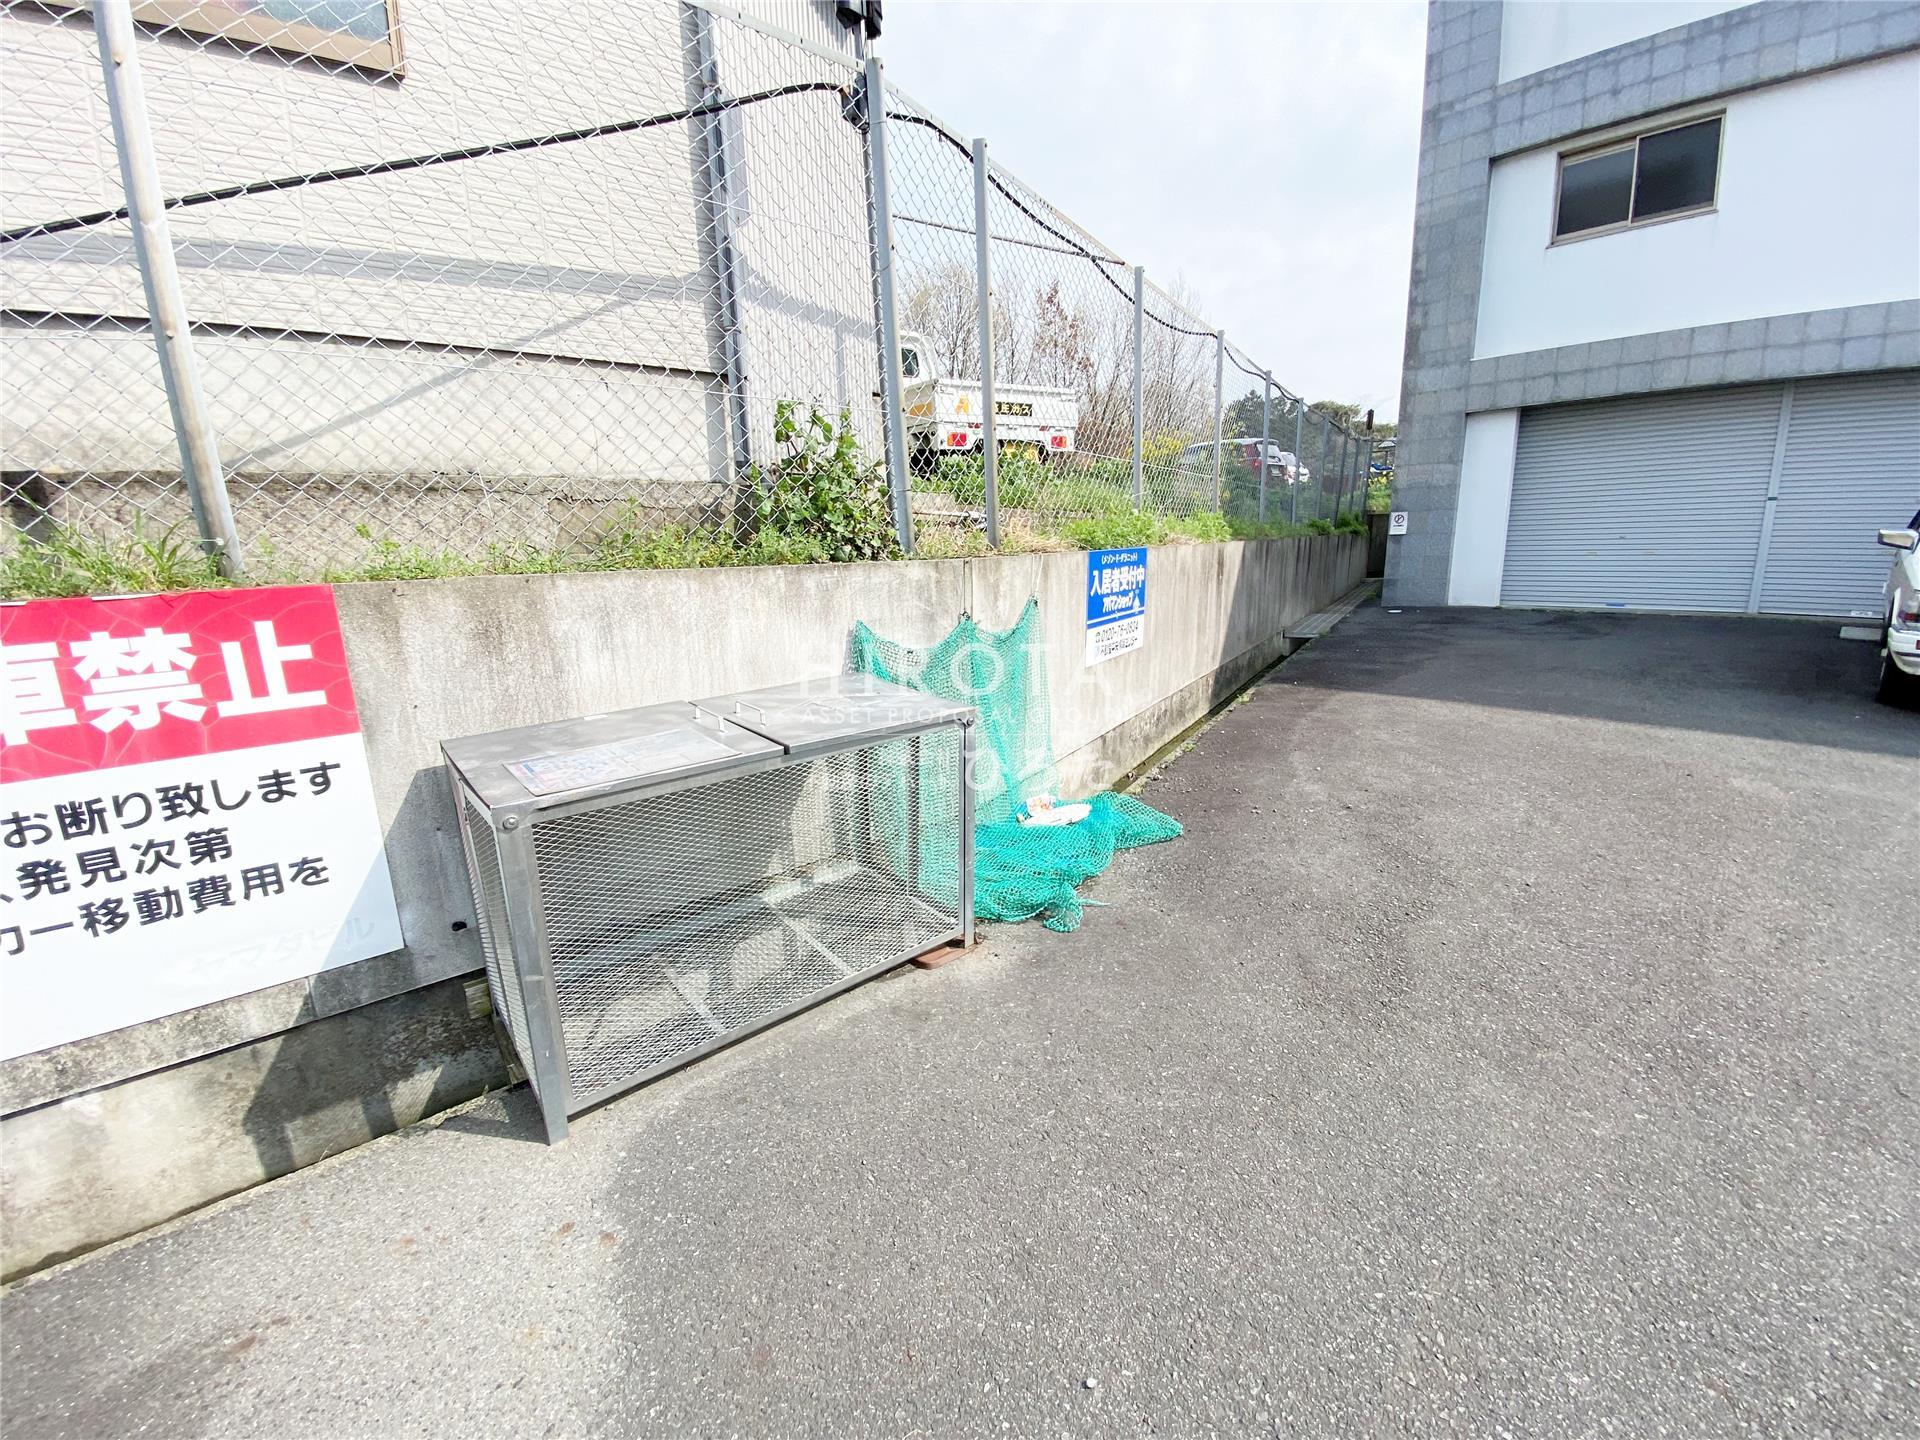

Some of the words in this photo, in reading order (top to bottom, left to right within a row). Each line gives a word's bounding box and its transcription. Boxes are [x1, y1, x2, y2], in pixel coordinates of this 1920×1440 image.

[1090, 564, 1145, 597] 入居者受付中
[0, 761, 341, 848] お断り致します
